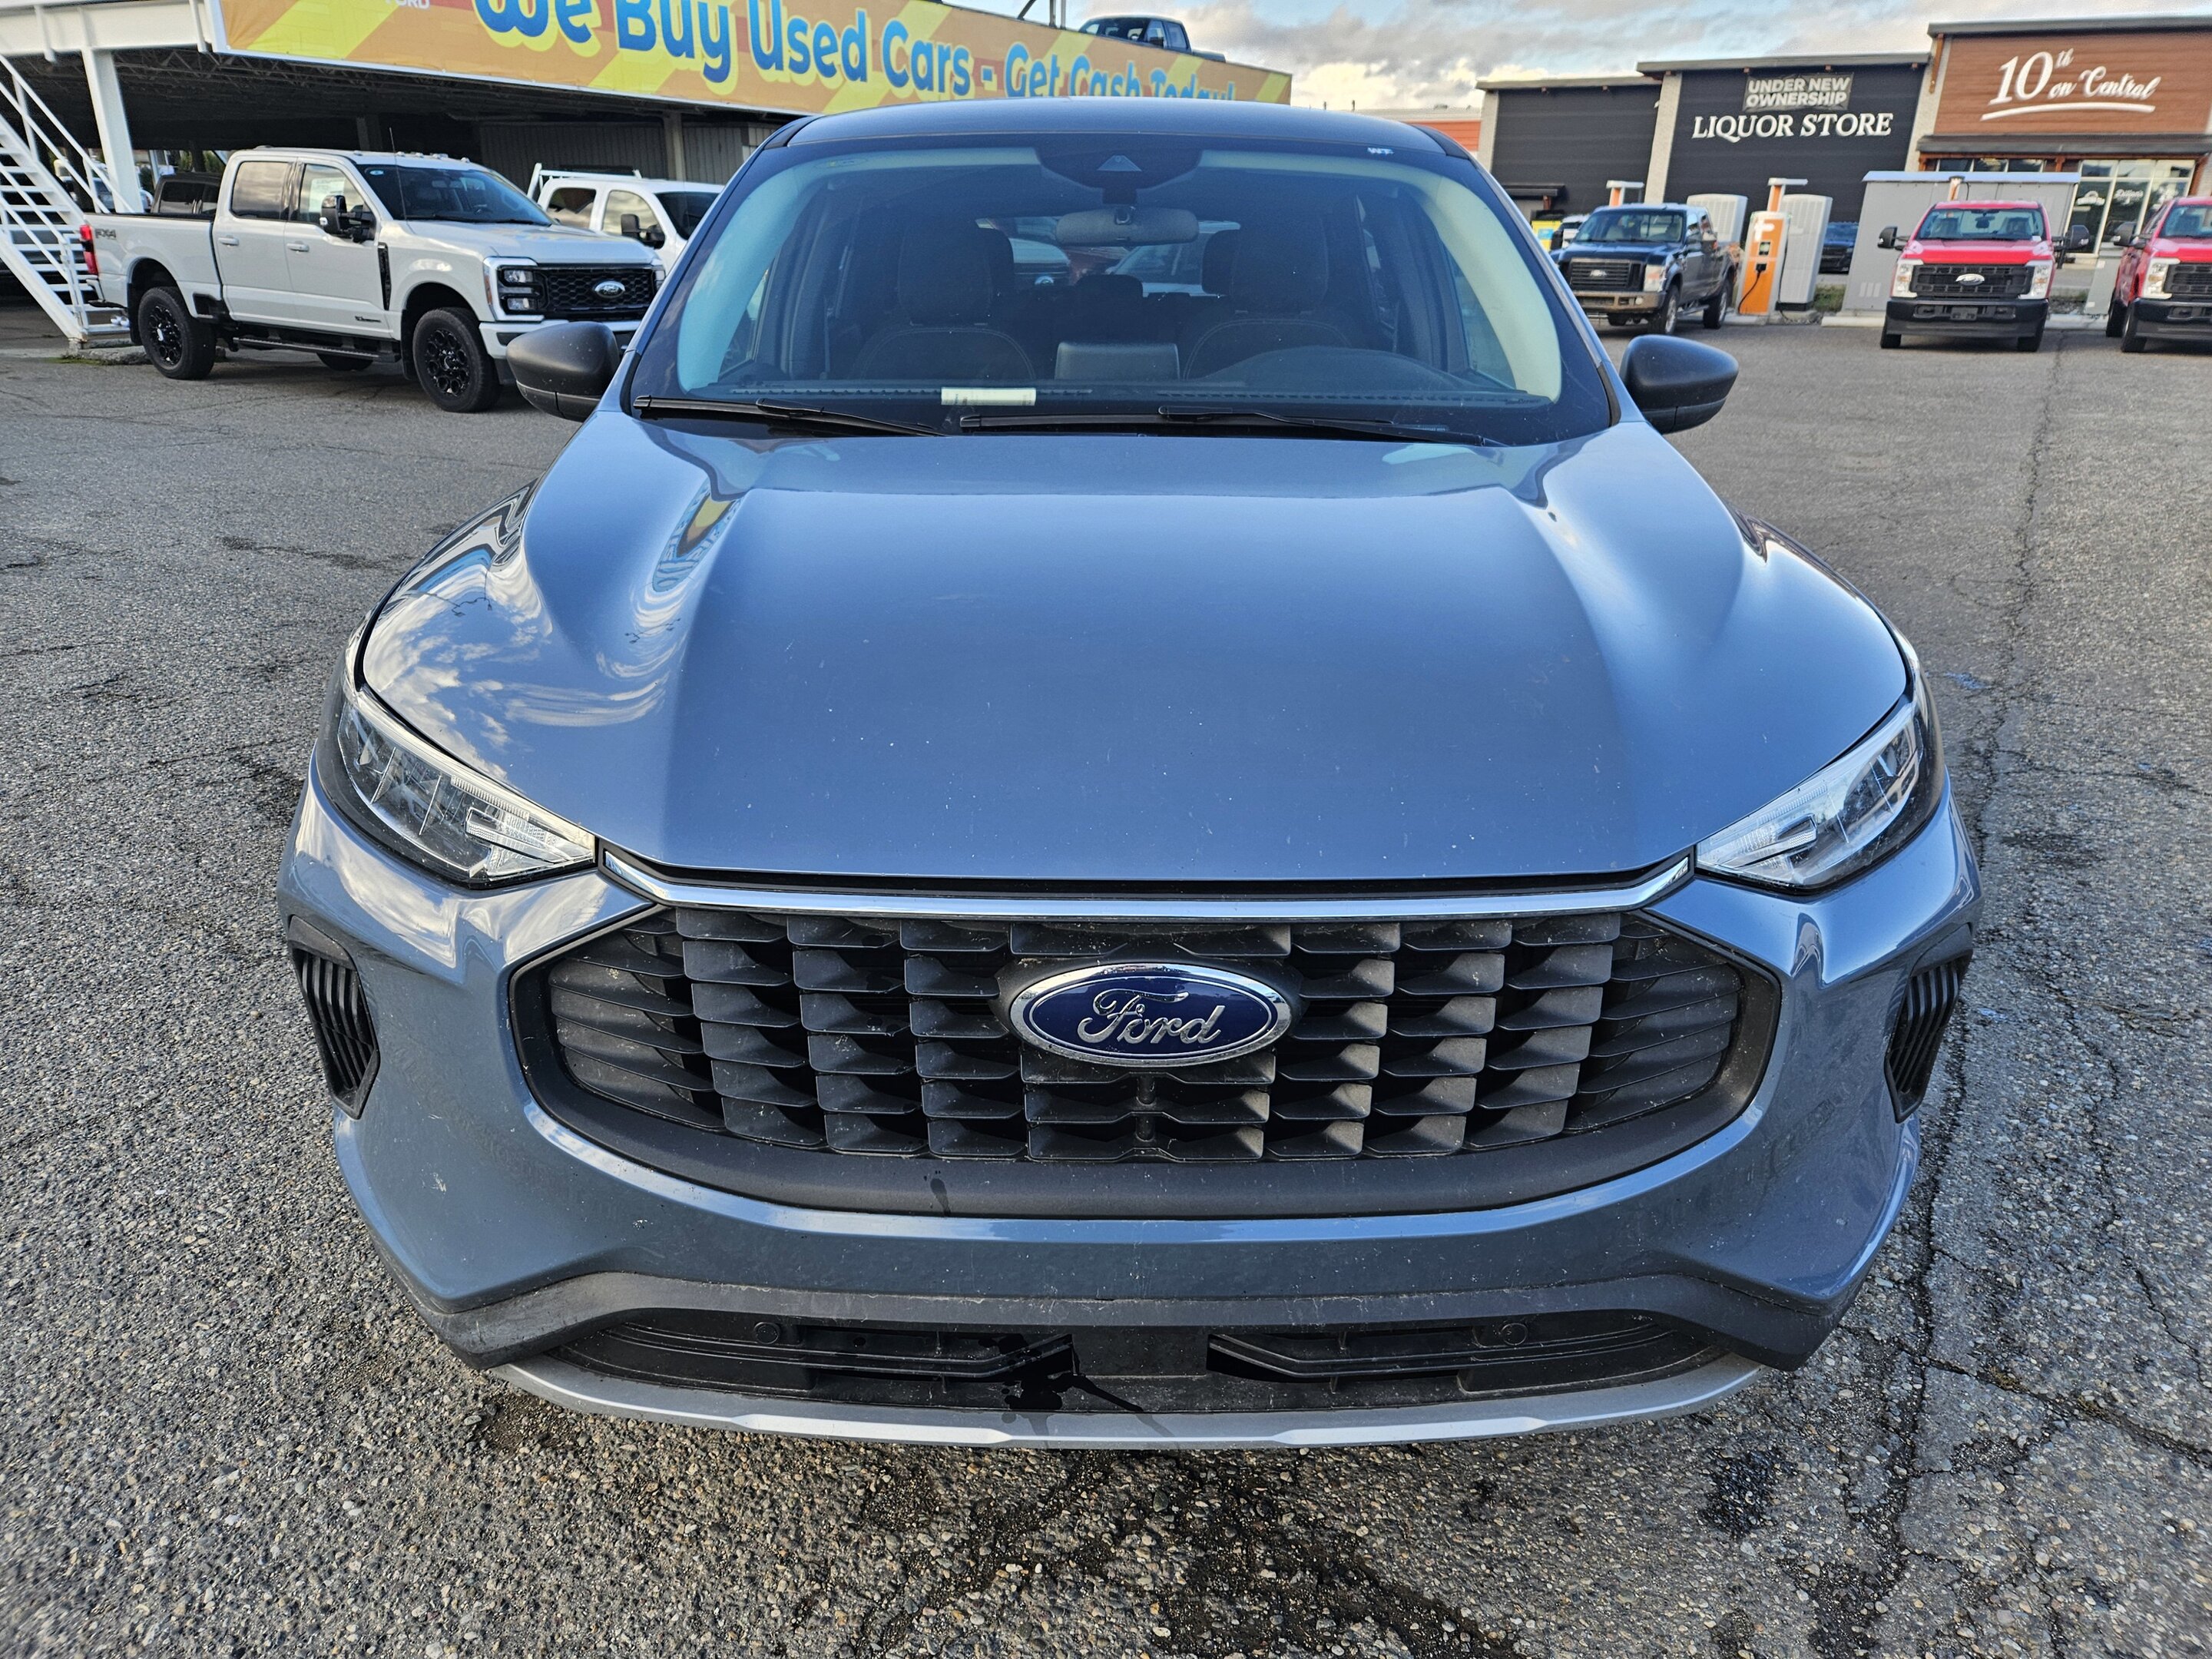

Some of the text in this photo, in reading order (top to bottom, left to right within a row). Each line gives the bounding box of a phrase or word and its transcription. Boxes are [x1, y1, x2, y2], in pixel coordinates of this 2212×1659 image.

[615, 0, 730, 83] Buy
[747, 0, 868, 83] Used
[882, 19, 971, 97] Cars
[1005, 42, 1060, 98] Get
[1071, 55, 1141, 97] Cash
[1746, 91, 1848, 108] OWNERSHIP
[1748, 77, 1851, 94] UNDER NEW
[2048, 65, 2162, 101] on Central
[1691, 113, 1894, 144] LIQUOR STORE
[1077, 988, 1226, 1045] Ford
